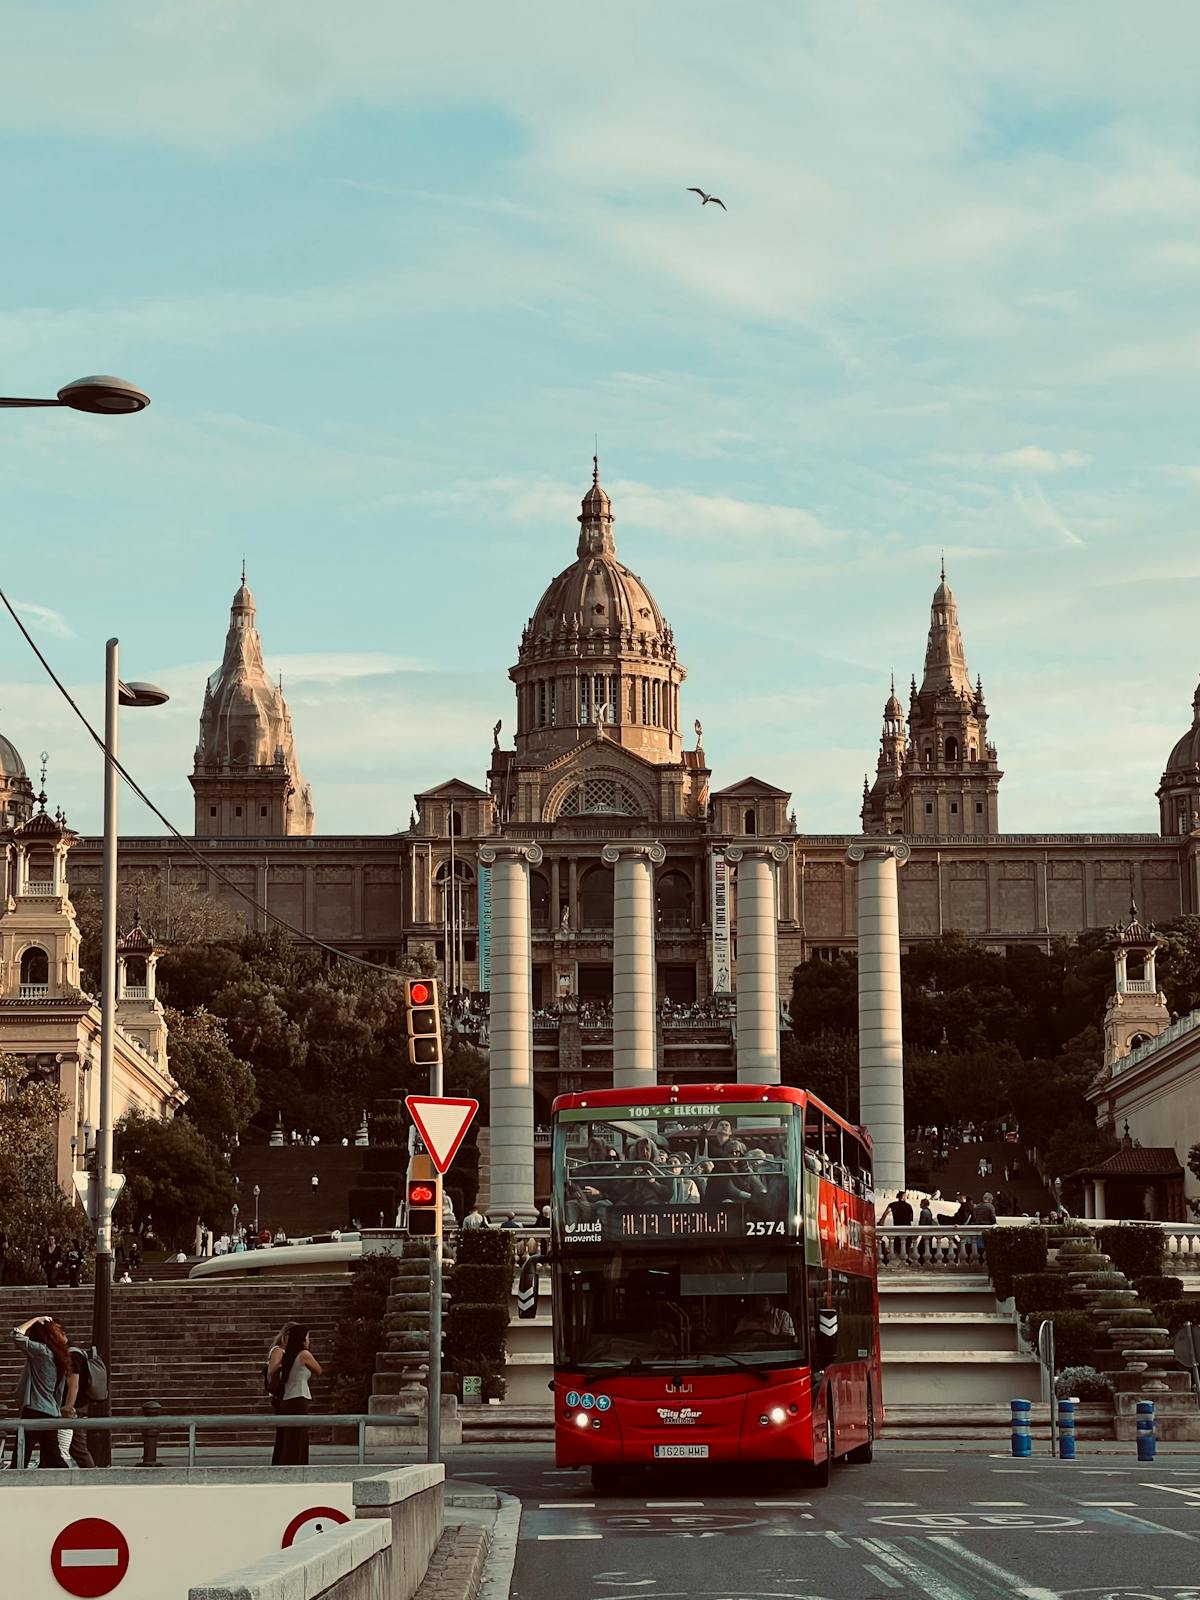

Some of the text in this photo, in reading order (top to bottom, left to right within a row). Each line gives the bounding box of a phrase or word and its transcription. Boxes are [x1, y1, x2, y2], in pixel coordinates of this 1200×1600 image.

[484, 868, 492, 908] CATALUNYA
[716, 883, 726, 907] CONTRA
[484, 909, 492, 919] DE
[716, 908, 726, 925] TINTA
[673, 1105, 721, 1115] ELECTRIC
[745, 1221, 785, 1236] 2574
[564, 1234, 602, 1243] moventis
[657, 1408, 702, 1419] City Tour
